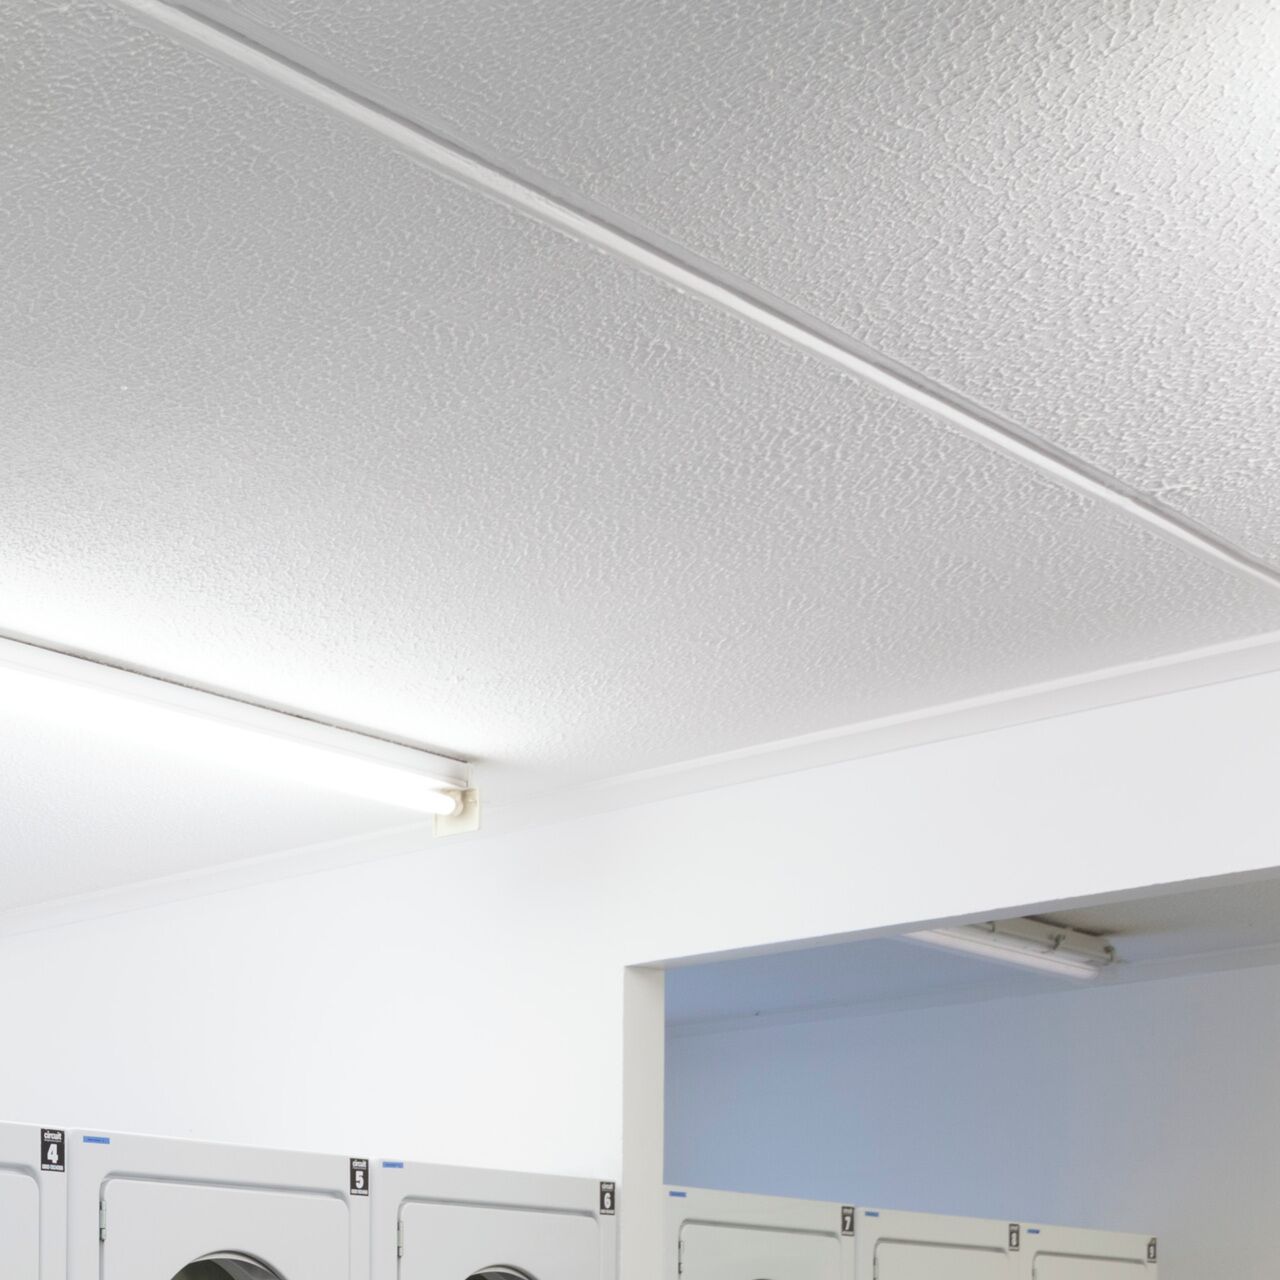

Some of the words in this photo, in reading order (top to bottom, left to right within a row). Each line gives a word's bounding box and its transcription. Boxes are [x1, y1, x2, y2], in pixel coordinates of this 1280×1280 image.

[47, 1144, 58, 1163] 4
[356, 1171, 364, 1188] 5
[604, 1193, 611, 1208] 6
